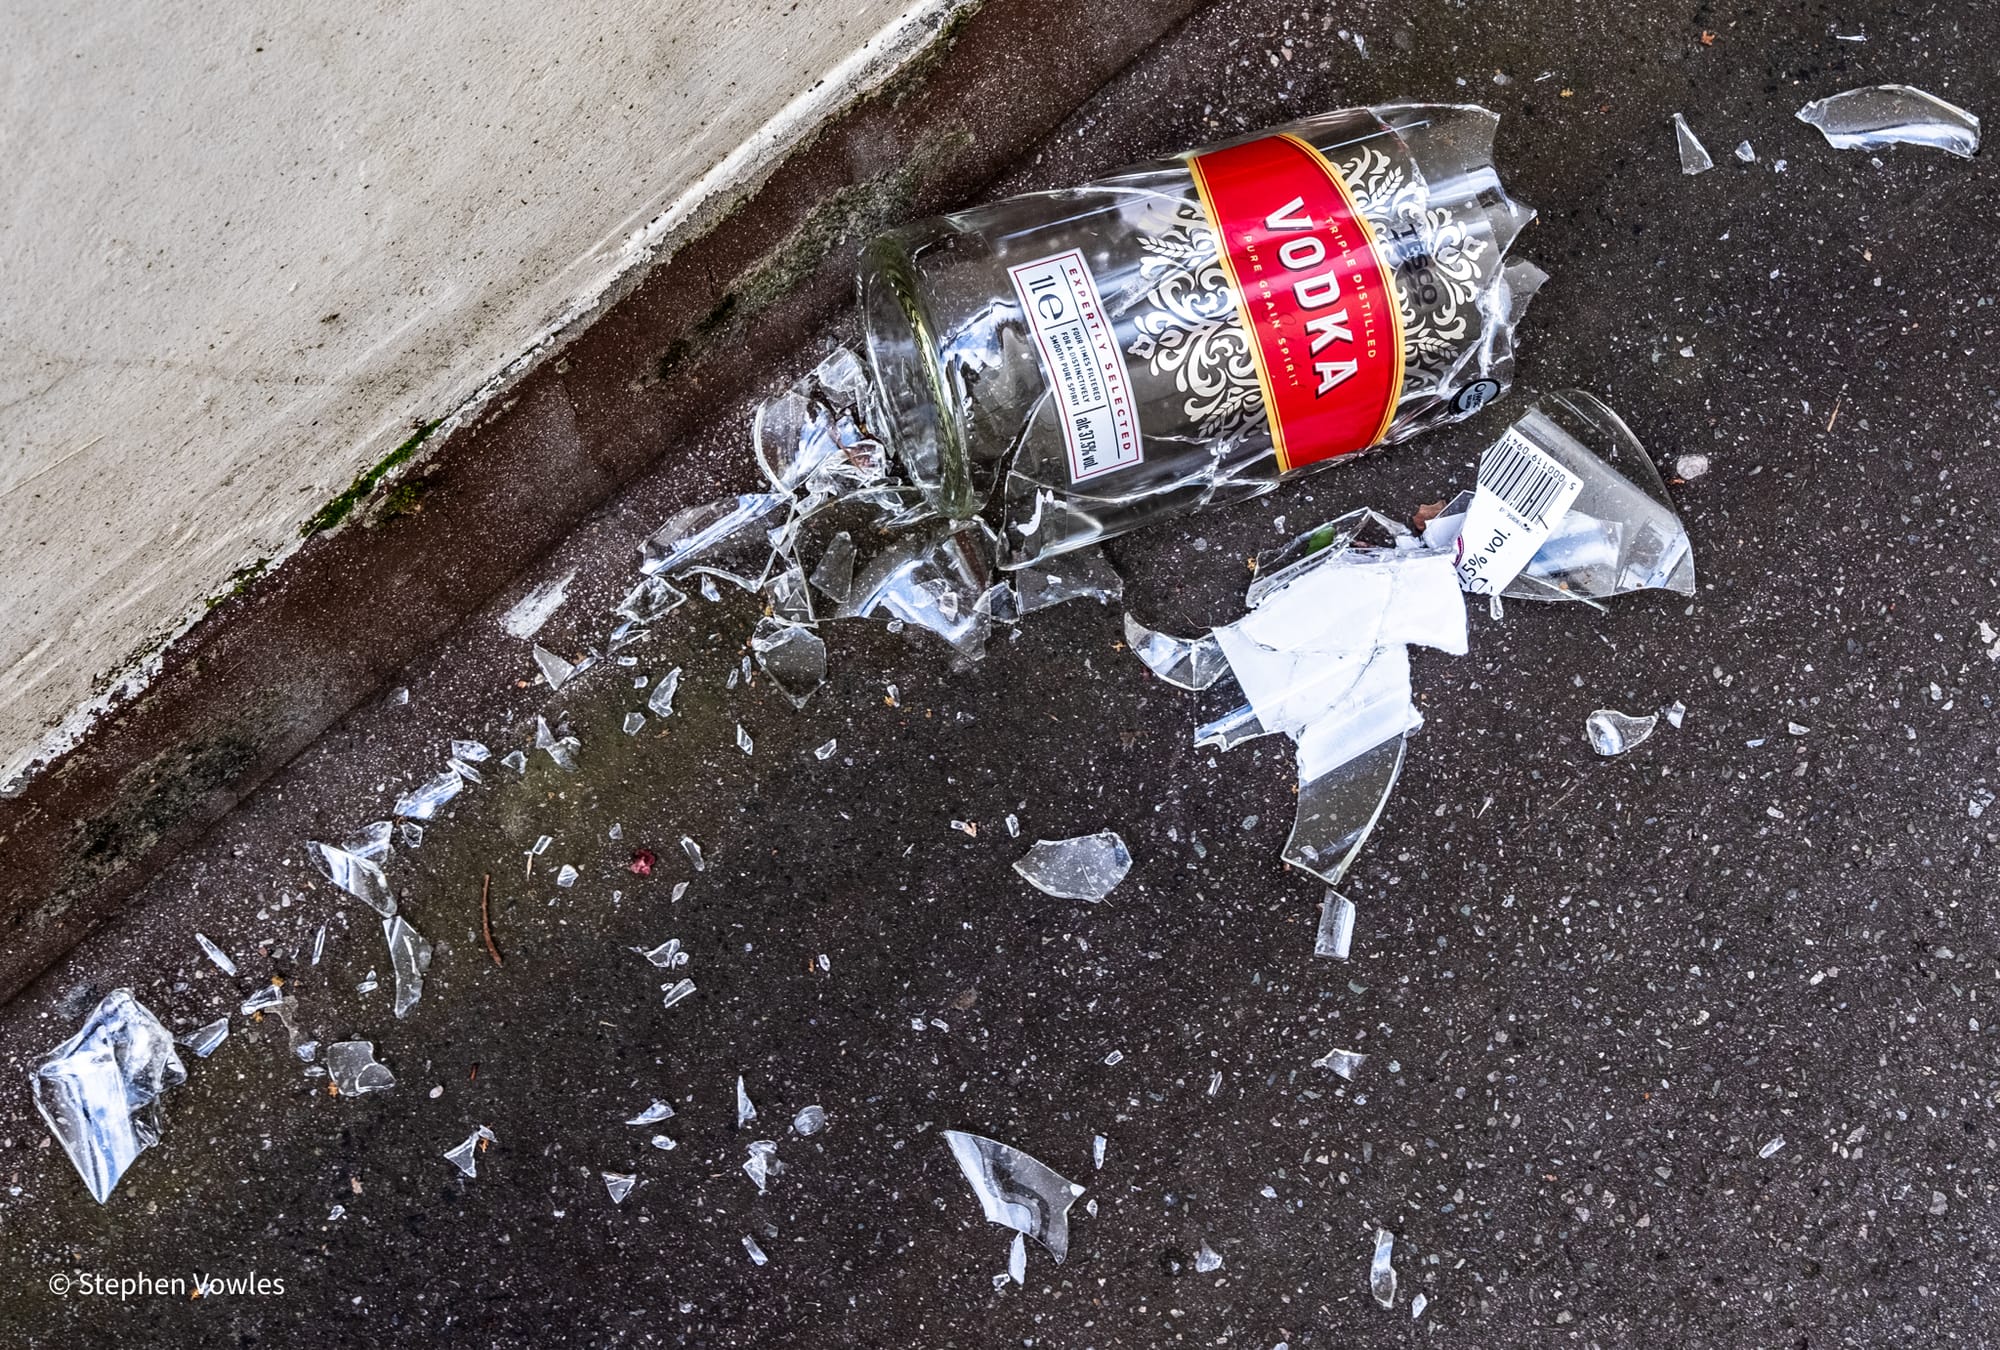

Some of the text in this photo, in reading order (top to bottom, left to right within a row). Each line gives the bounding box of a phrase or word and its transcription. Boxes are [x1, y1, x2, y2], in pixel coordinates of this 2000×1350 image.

[1265, 196, 1358, 397] VODKA
[1325, 217, 1377, 358] TRIPLE DISTILLED
[1401, 223, 1438, 305] TESCO
[1243, 234, 1298, 388] PURE GRAIN SPIRIT
[1049, 334, 1080, 406] SMOOTH PURE SPIRIT
[1061, 331, 1072, 345] FOR
[1069, 352, 1090, 403] DISTINCTIVELY
[1069, 268, 1131, 451] EXPERTLY SELECTED
[1071, 327, 1101, 401] FOUR TIMES FILTERED
[1078, 430, 1097, 456] 37.5%
[1485, 528, 1511, 555] vol.
